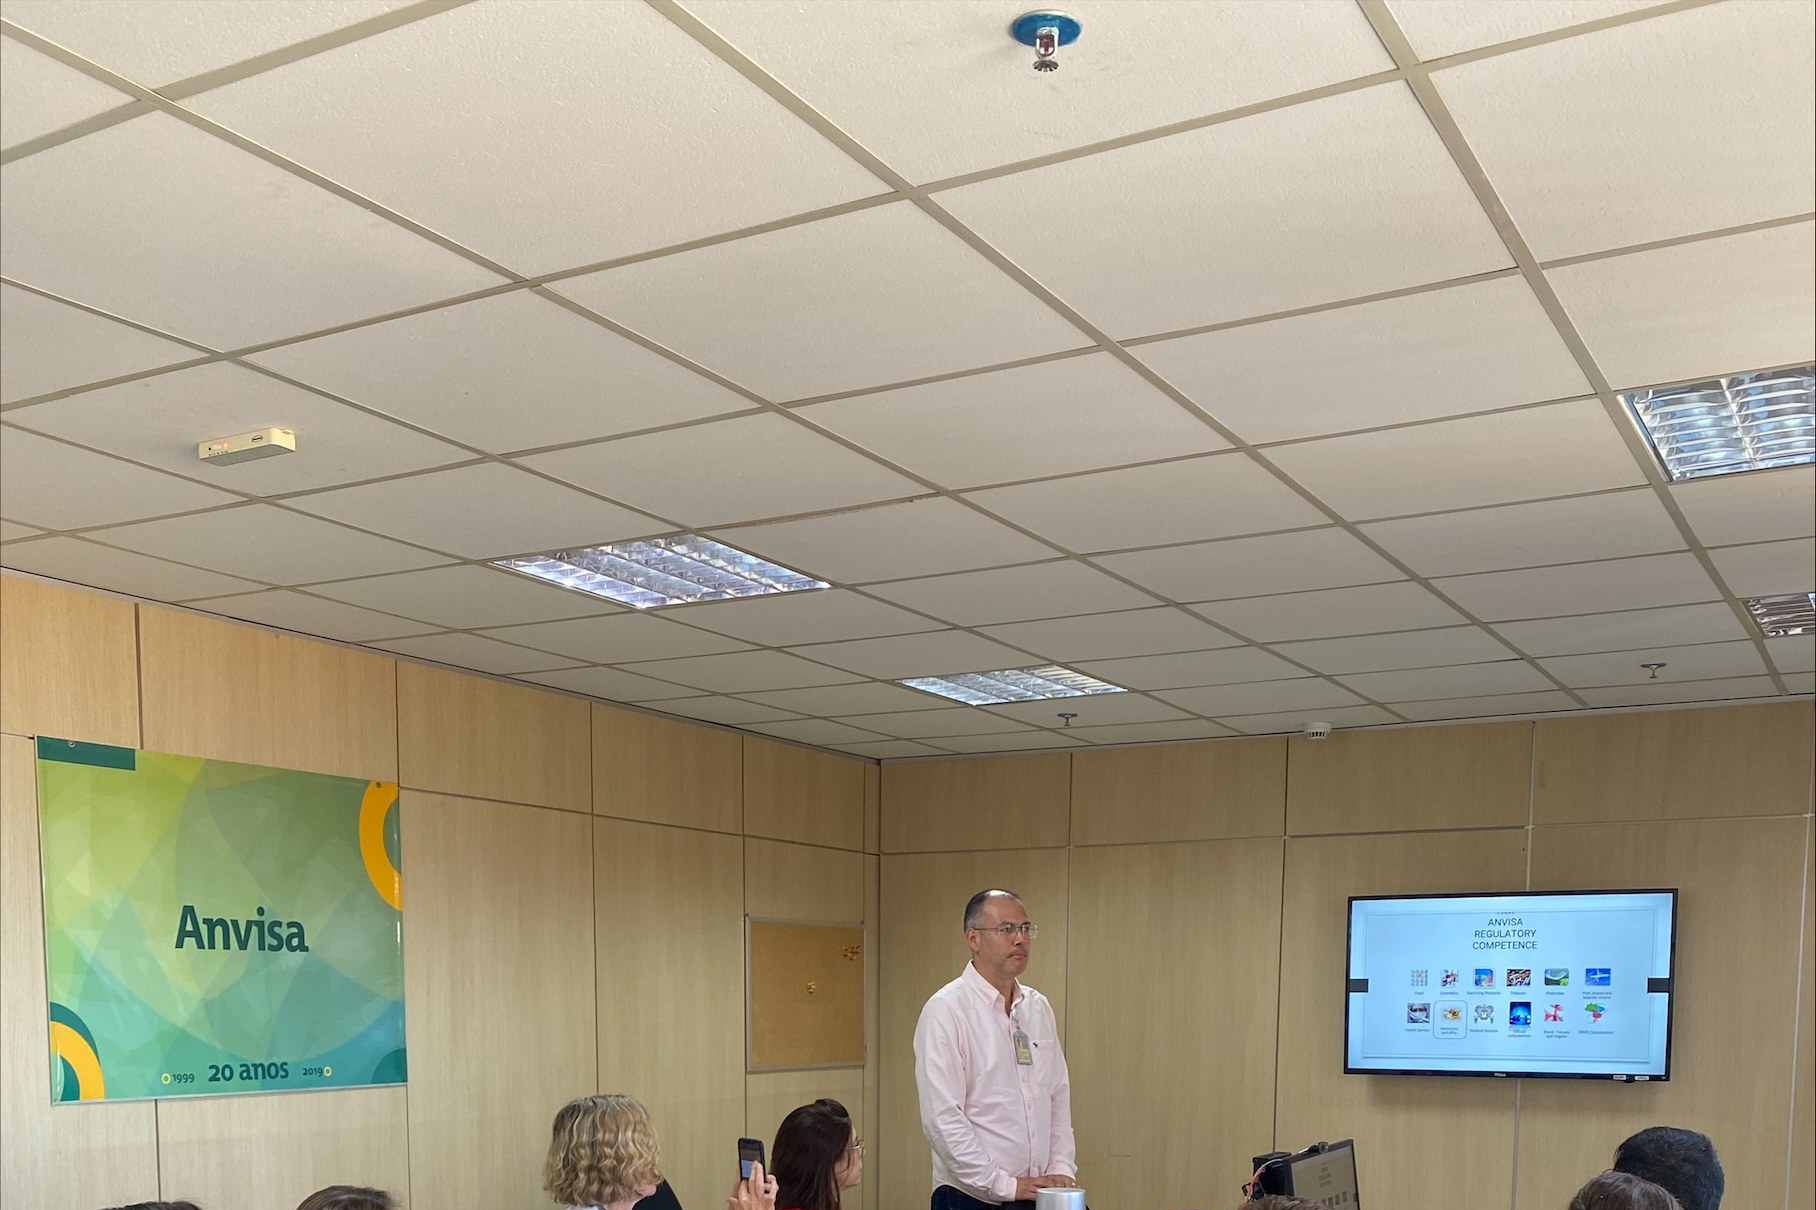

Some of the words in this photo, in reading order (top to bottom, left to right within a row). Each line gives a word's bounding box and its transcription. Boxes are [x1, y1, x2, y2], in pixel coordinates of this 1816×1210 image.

[1487, 917, 1524, 927] ANVISA
[175, 905, 309, 952] Anvisa
[1474, 929, 1537, 938] REGULATORY
[1472, 940, 1539, 950] COMPETENCE
[208, 1064, 233, 1083] 20
[239, 1061, 289, 1081] anos
[302, 1066, 323, 1077] 2019
[172, 1073, 195, 1084] 1999
